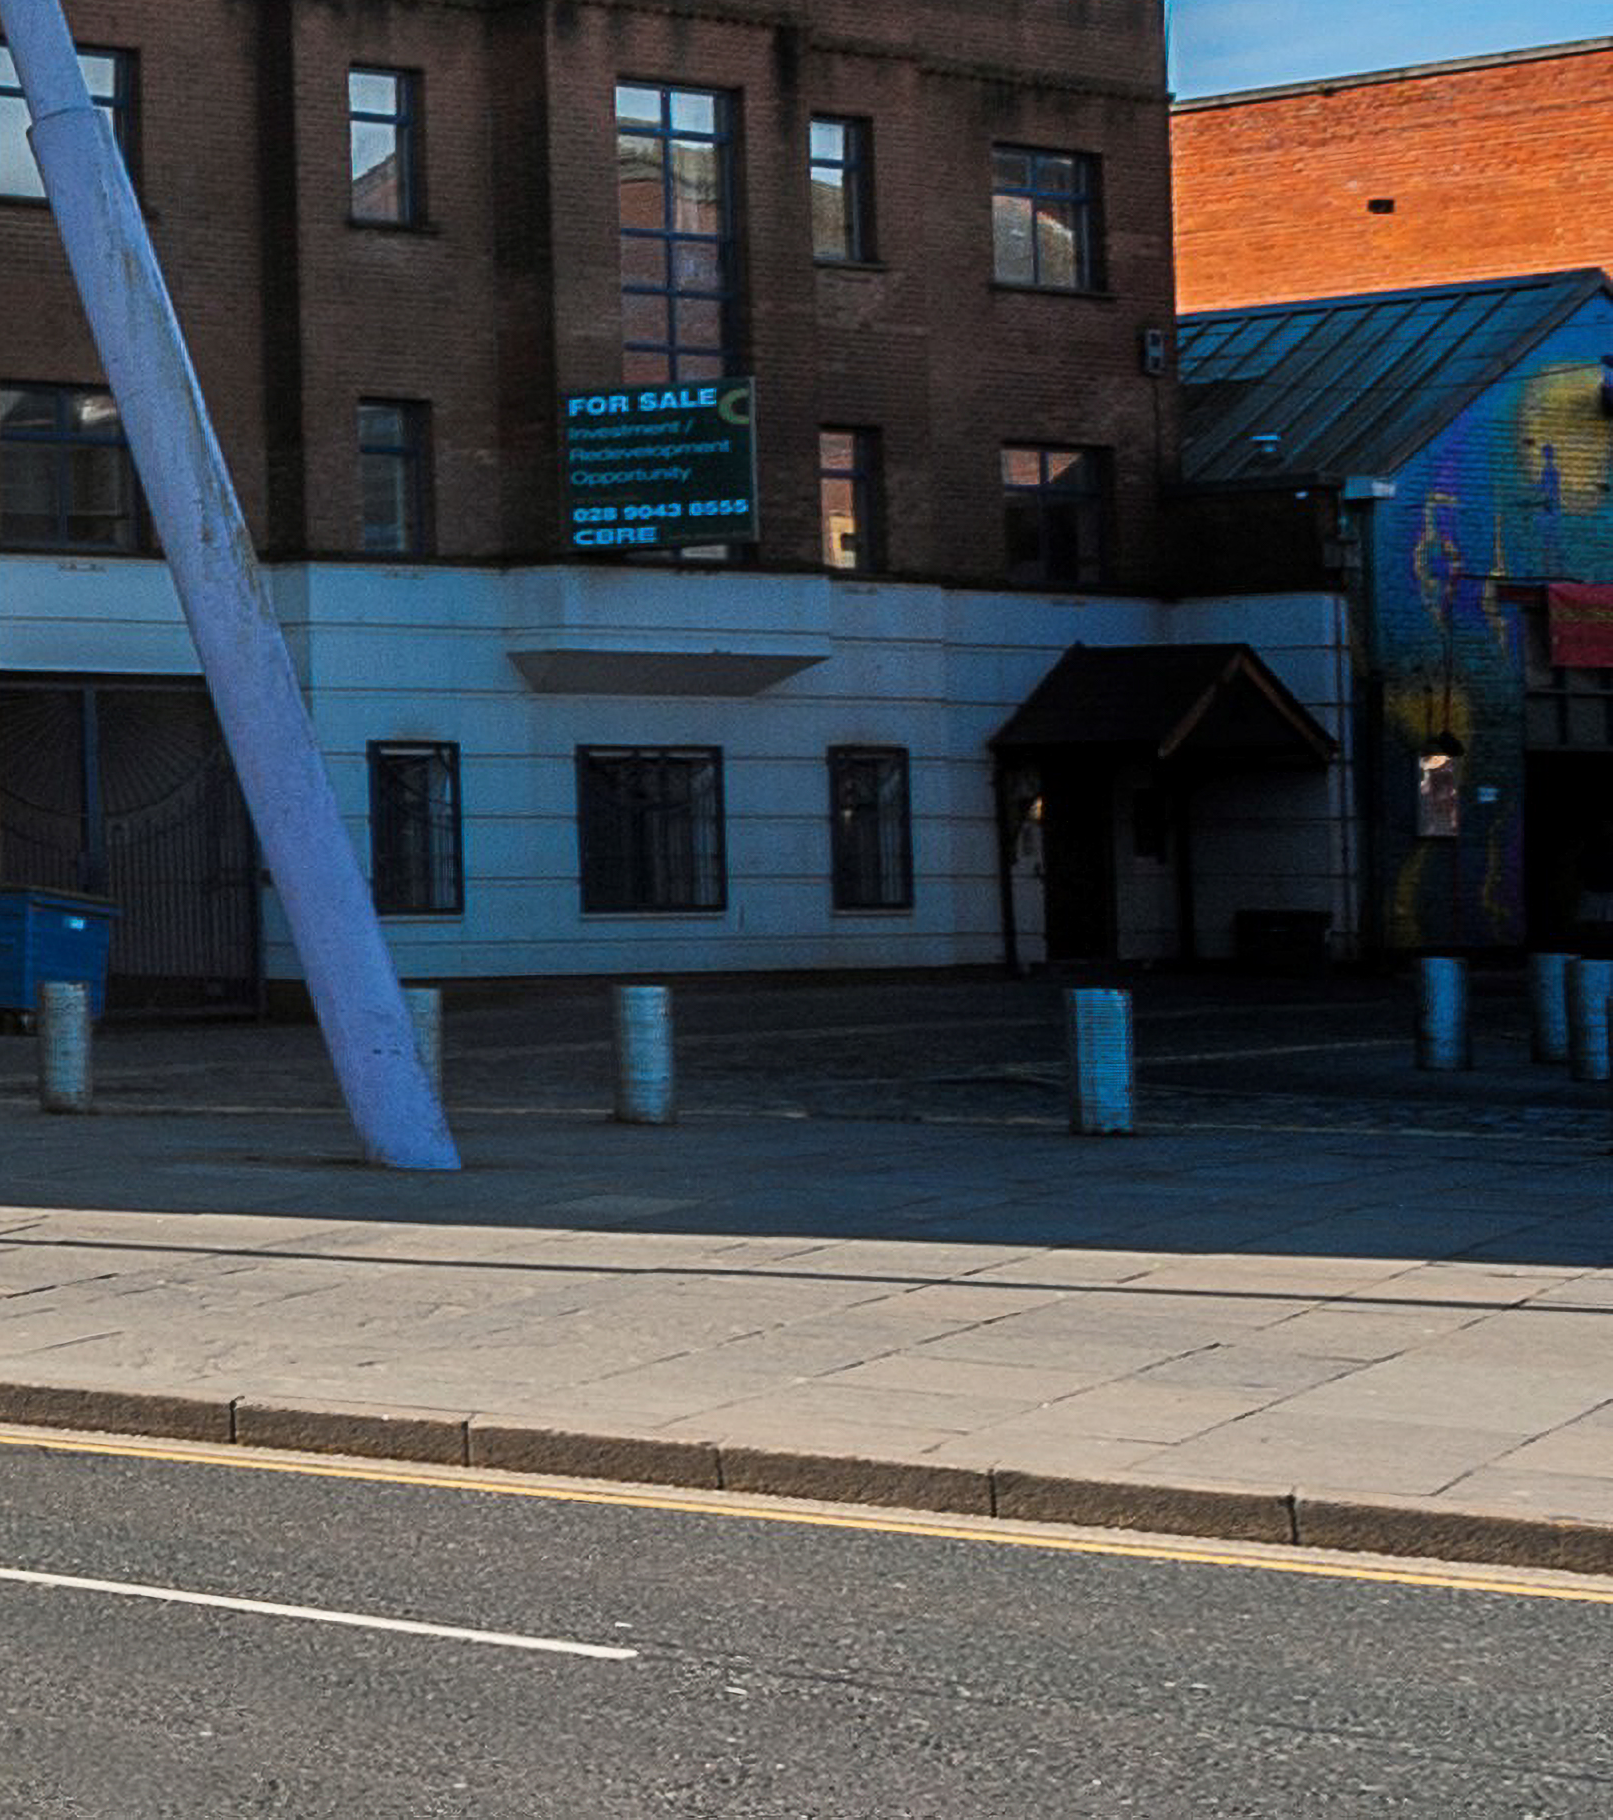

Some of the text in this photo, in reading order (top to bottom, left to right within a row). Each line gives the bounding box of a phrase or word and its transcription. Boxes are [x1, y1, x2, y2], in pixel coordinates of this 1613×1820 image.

[568, 387, 717, 417] FOR SALE
[569, 439, 731, 462] Redevelopment
[571, 466, 692, 487] Opportunity
[573, 507, 618, 523] 028
